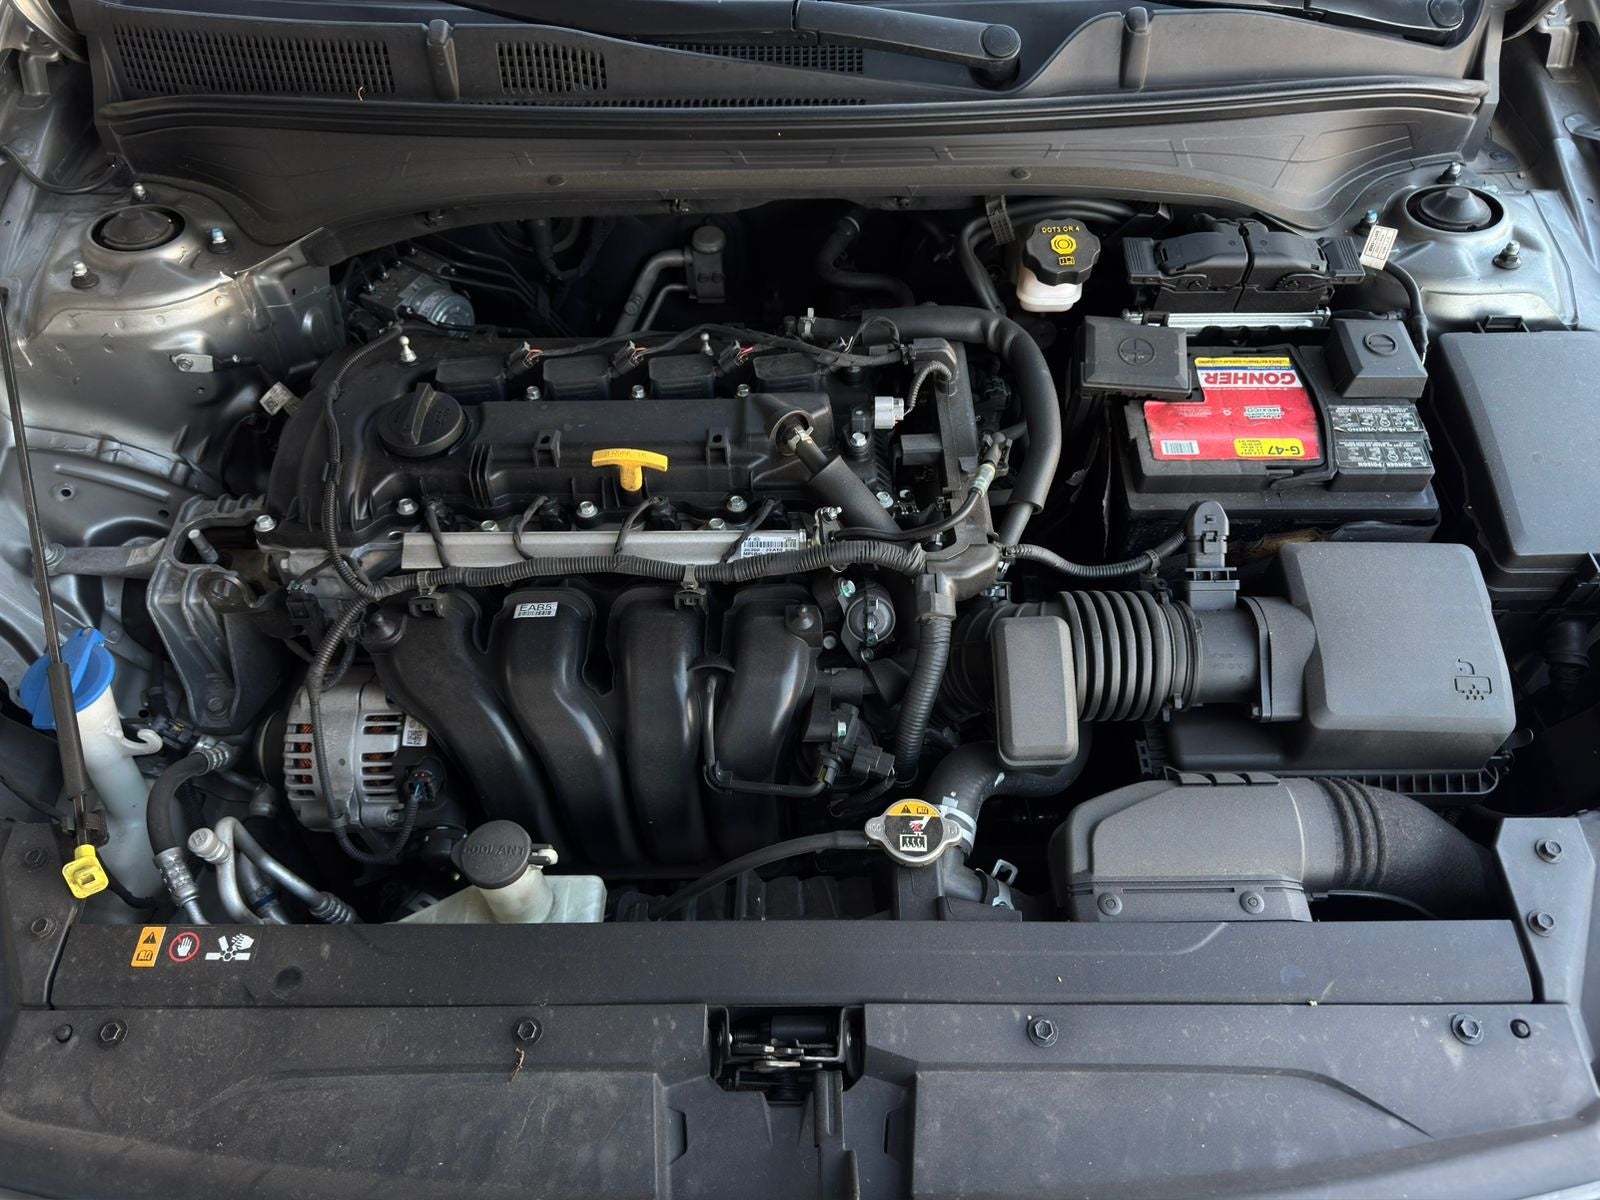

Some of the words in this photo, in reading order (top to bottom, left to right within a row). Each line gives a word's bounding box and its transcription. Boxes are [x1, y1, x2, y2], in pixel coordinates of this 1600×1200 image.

[1204, 372, 1296, 385] GONHER
[1267, 445, 1300, 456] G-47
[519, 603, 552, 612] EAB5
[463, 844, 525, 856] COOLANT
